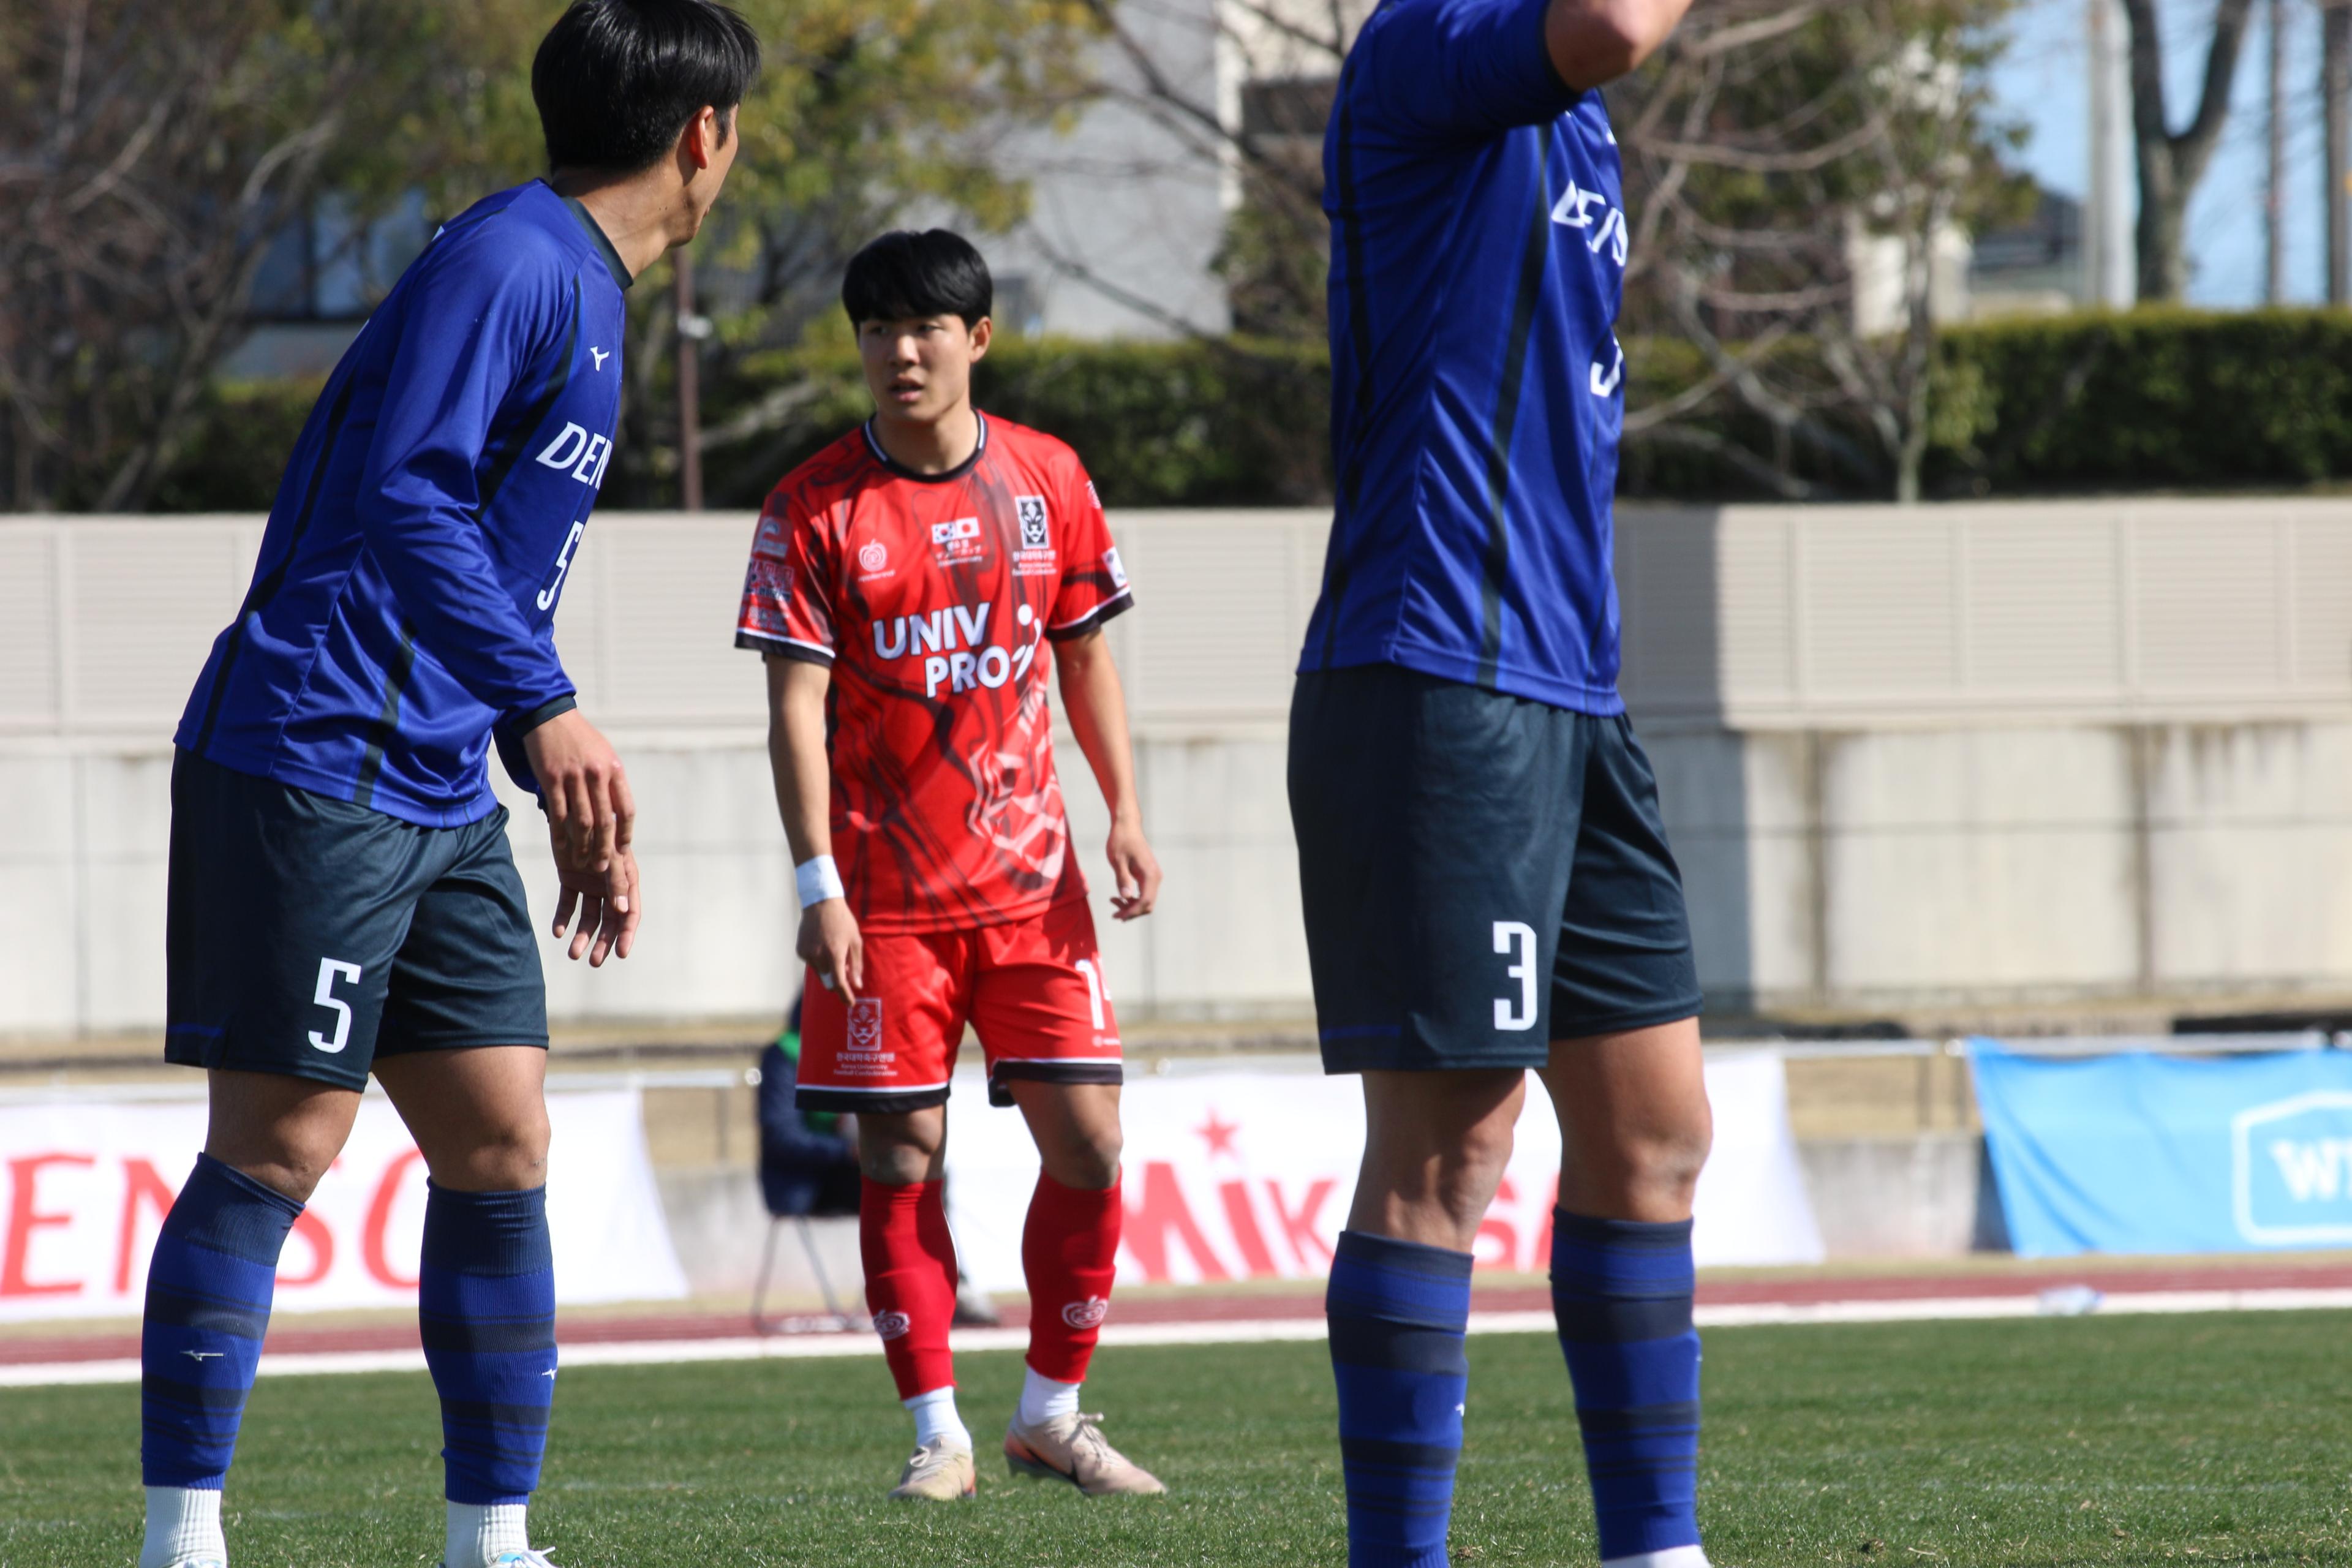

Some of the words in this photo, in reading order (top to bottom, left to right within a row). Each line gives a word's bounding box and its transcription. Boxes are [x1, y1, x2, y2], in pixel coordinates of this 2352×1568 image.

[537, 520, 584, 611] 5
[872, 601, 990, 660] UNIV
[925, 645, 1011, 699] PRO
[307, 957, 361, 1054] 5
[1492, 921, 1537, 1031] 3
